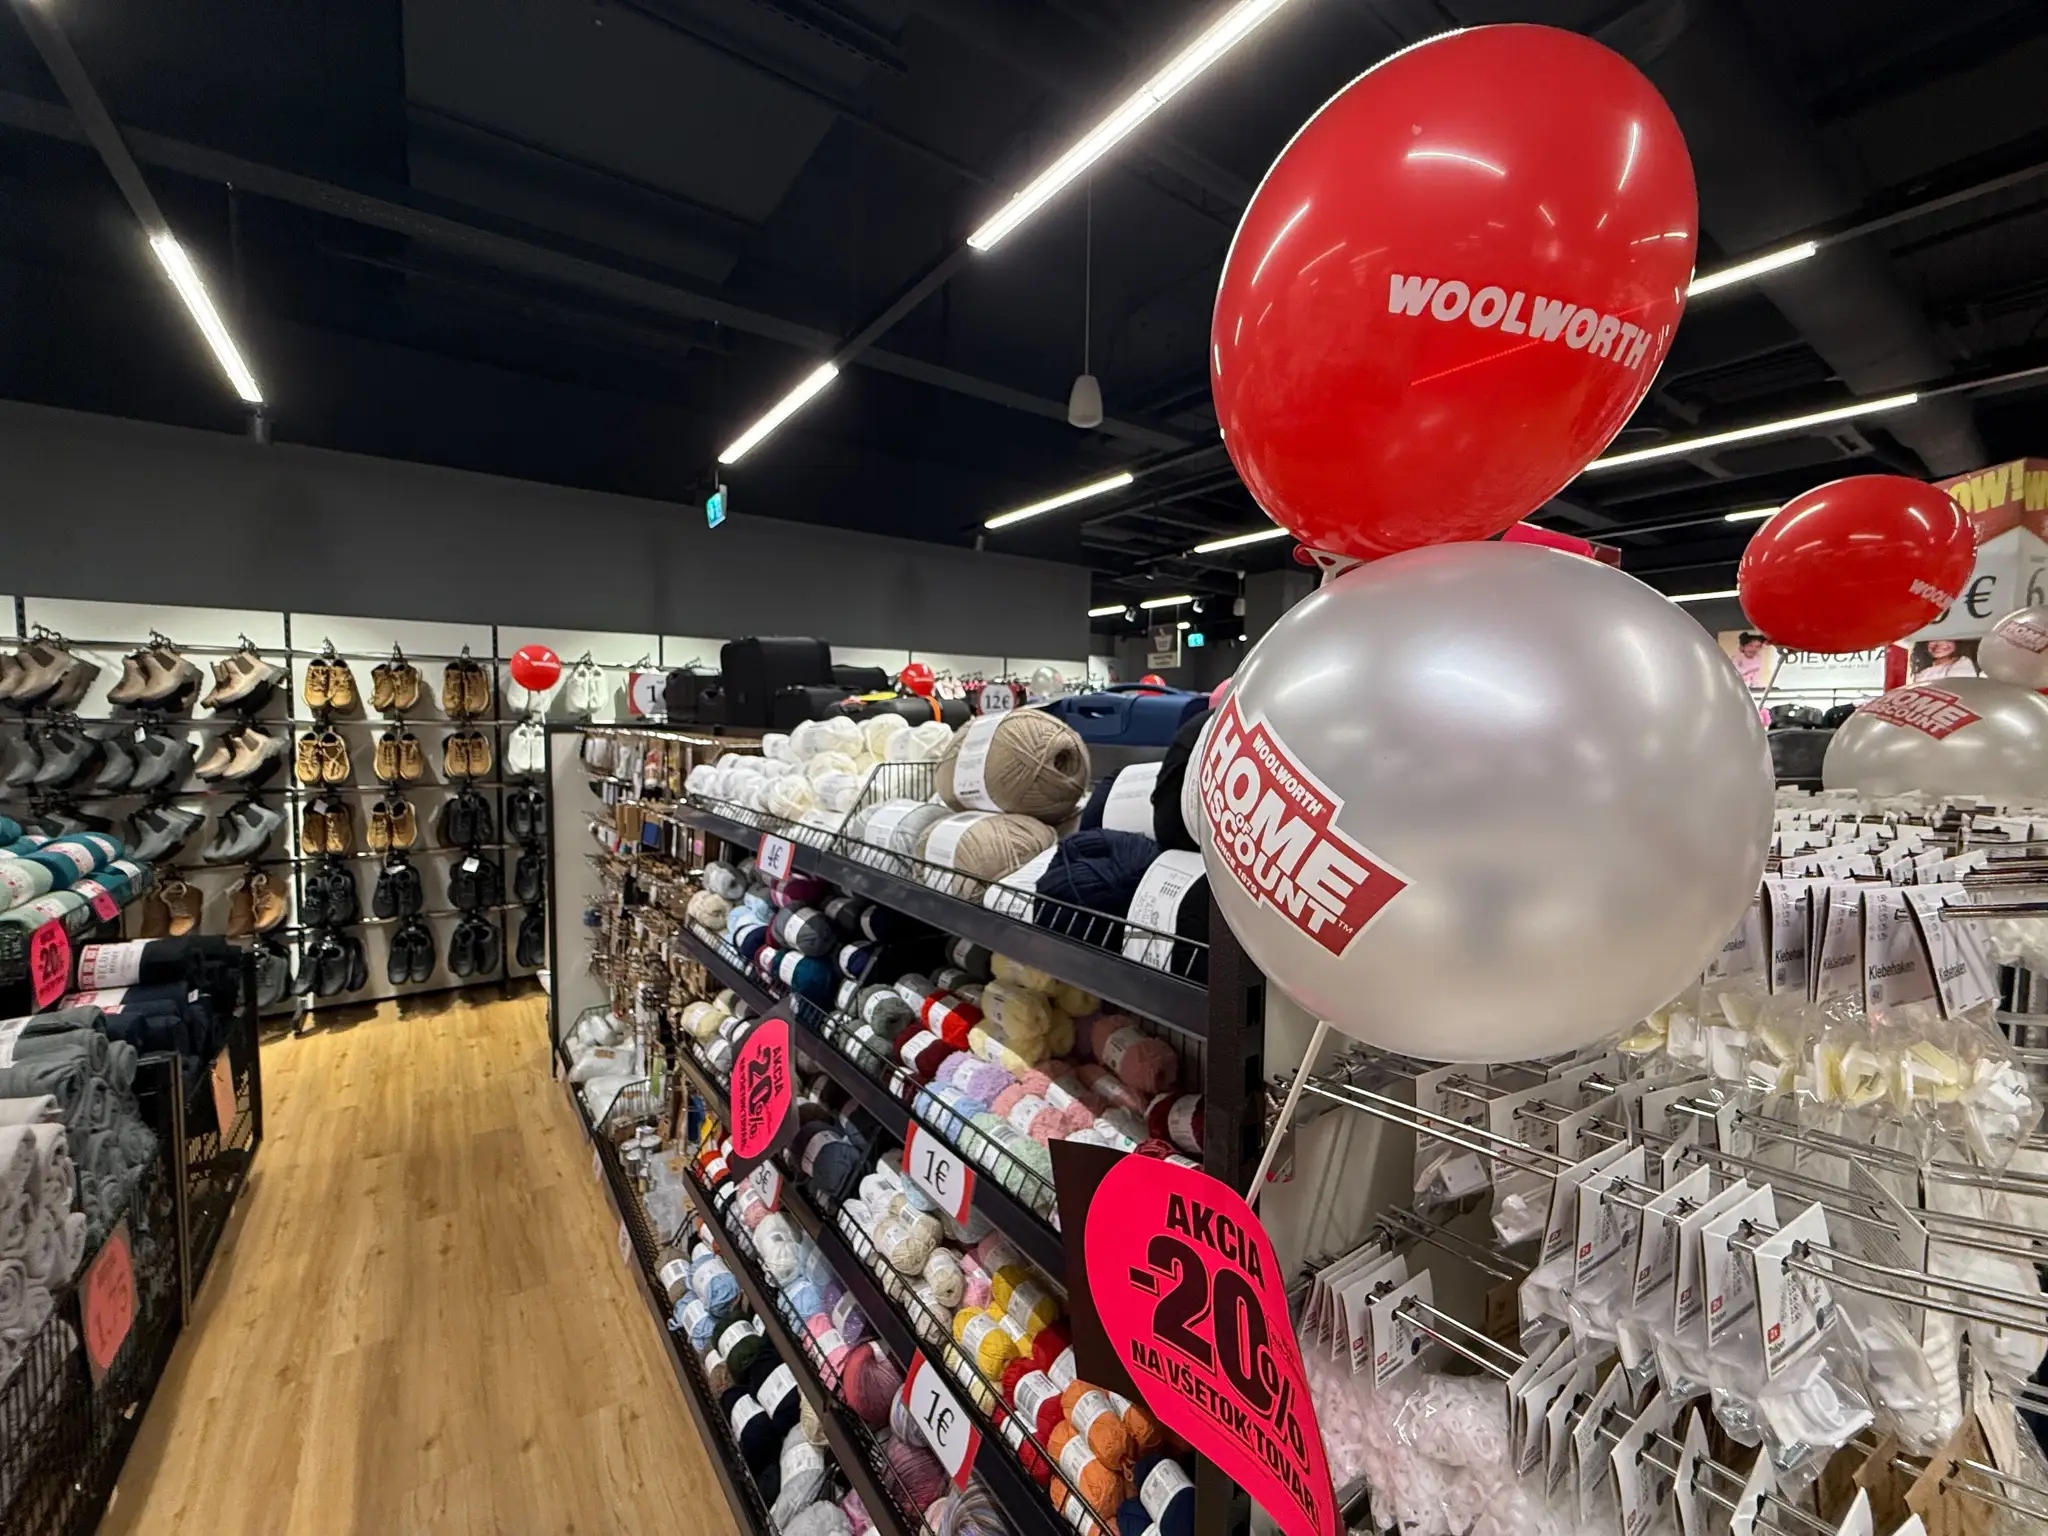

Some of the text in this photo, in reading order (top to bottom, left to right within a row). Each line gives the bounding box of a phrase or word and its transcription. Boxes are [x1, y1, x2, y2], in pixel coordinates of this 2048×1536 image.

[1388, 274, 1652, 369] WOOLWORTH
[1947, 461, 2024, 514] OW!
[985, 694, 1011, 710] 12€
[1210, 713, 1370, 917] HOME
[1252, 733, 1322, 817] WOOLWORTH
[1201, 757, 1338, 934] DISCOUNT
[1215, 836, 1258, 894] SINCE 1879
[1235, 812, 1254, 836] OF
[924, 1150, 950, 1196] 1€
[1165, 1192, 1266, 1291] AKCIA
[1128, 1235, 1310, 1473] -20%
[923, 1390, 955, 1447] 1€
[1131, 1339, 1165, 1380] NA
[1167, 1361, 1253, 1441] VŠETOK
[1253, 1430, 1319, 1520] TOVAR
